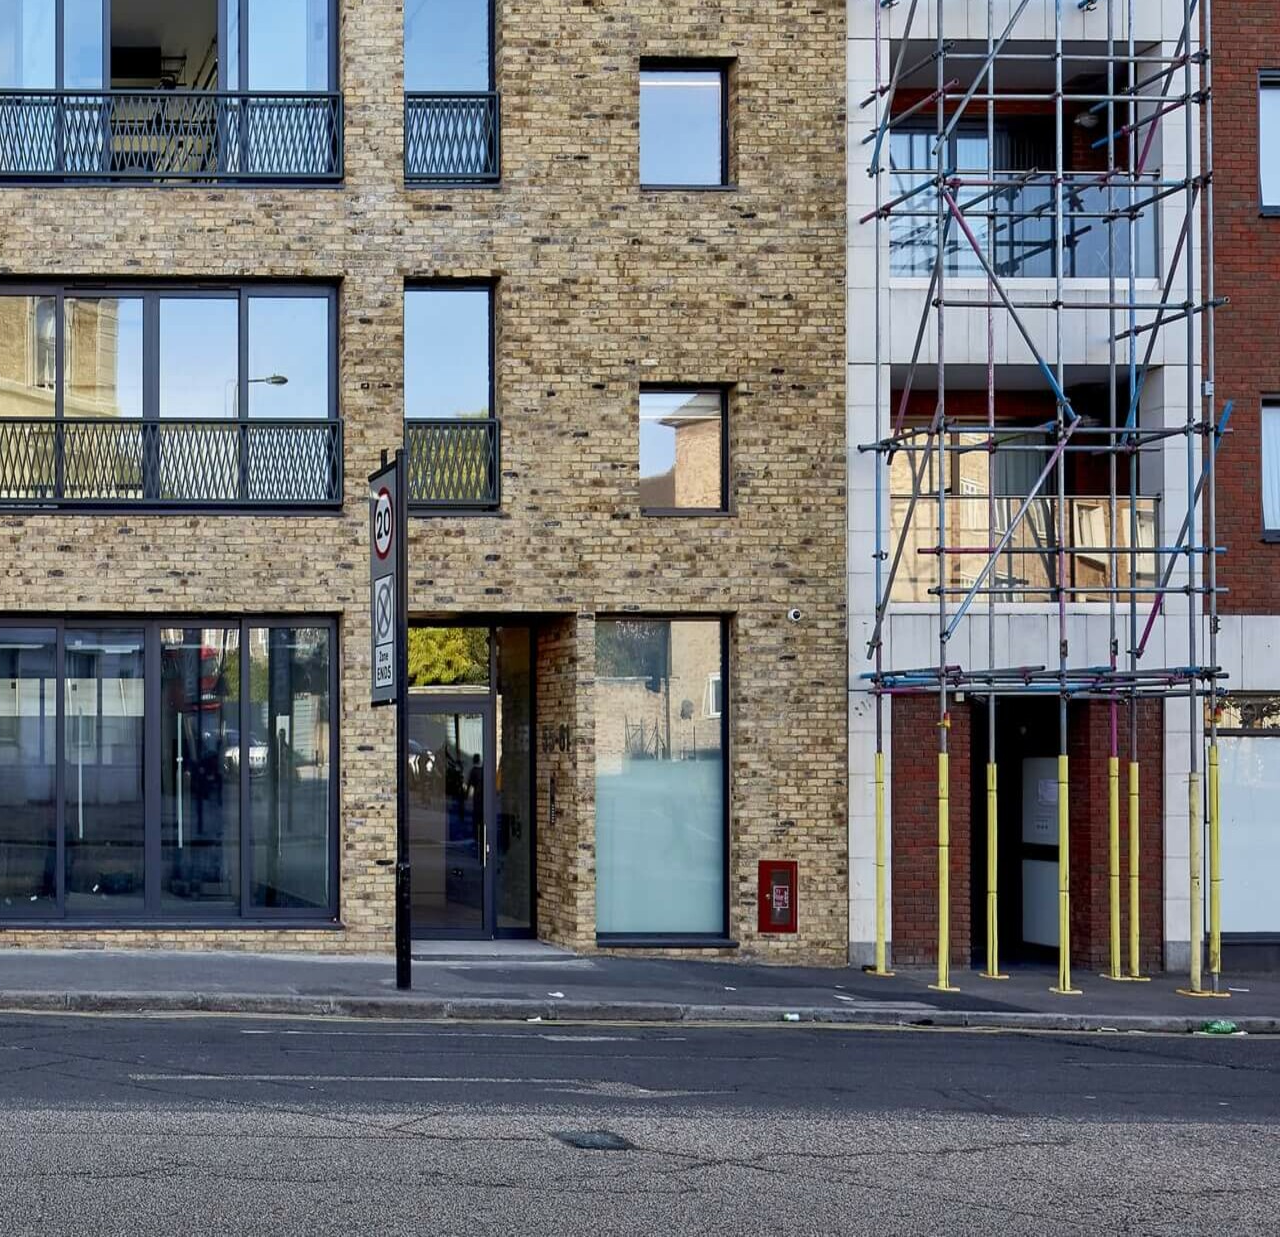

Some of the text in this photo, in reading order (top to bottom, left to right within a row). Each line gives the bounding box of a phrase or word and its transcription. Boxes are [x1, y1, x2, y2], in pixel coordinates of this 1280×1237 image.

[376, 506, 391, 540] 20
[378, 650, 389, 662] Zone
[377, 664, 392, 681] ENDS
